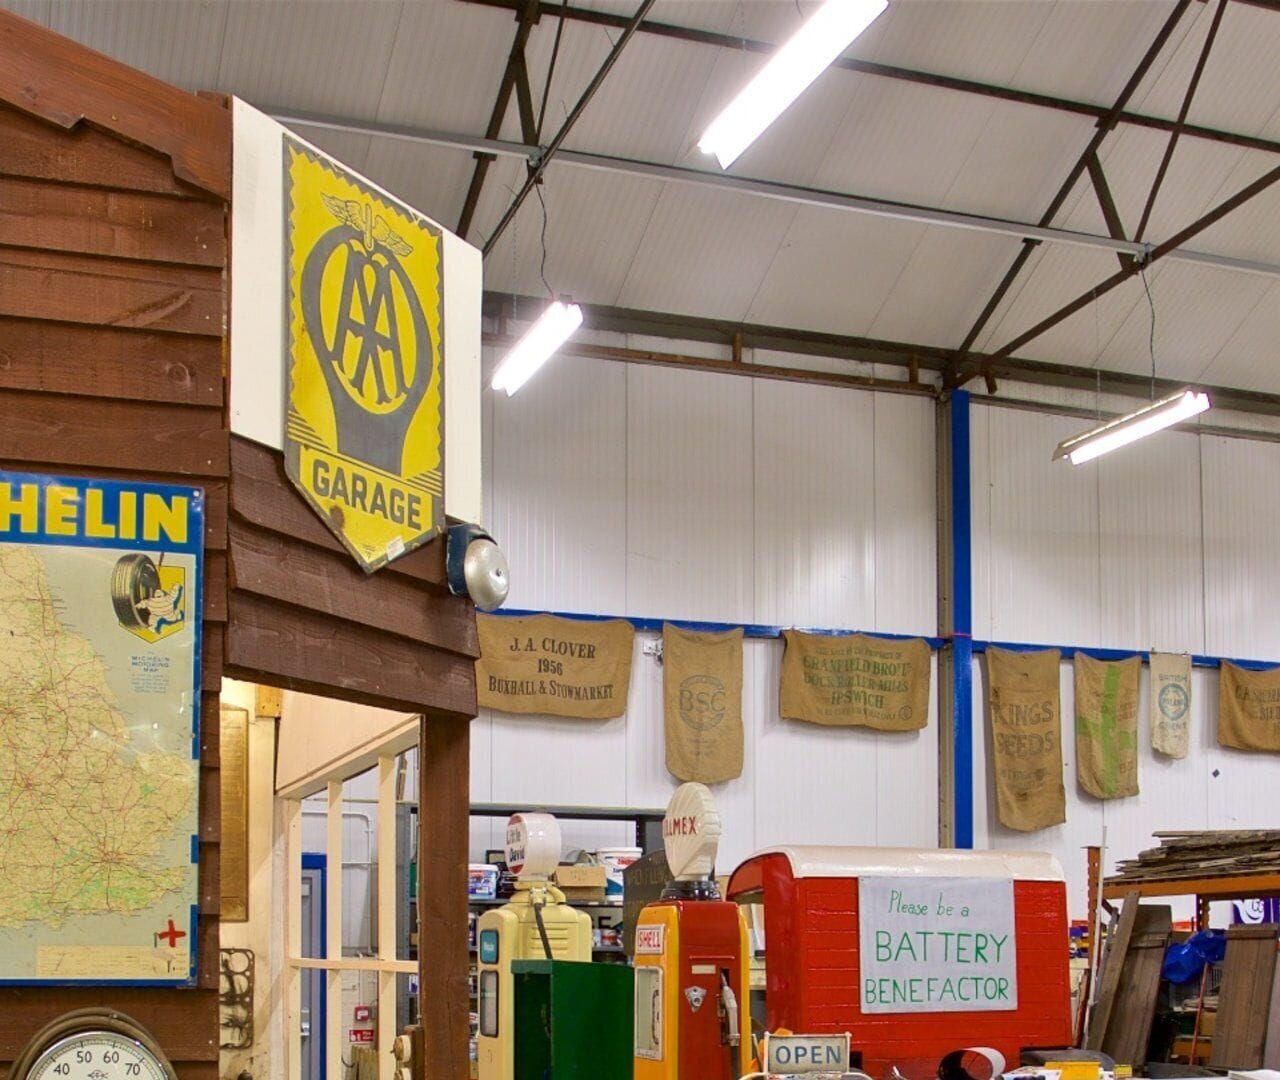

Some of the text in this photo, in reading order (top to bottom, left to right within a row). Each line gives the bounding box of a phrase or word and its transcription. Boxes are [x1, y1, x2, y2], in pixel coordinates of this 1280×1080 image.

[312, 458, 422, 531] GARAGE
[542, 637, 596, 659] CLOVER
[537, 659, 563, 676] 1956
[488, 675, 613, 701] BUXHALL & STOWMARKET
[679, 689, 726, 713] BSC
[831, 690, 885, 709] IPSWICH
[888, 890, 970, 918] Please be a
[638, 931, 661, 947] SHELL
[876, 930, 1009, 965] BATTERY
[865, 976, 1009, 1005] BENEFACTOR
[76, 1051, 93, 1063] 50
[103, 1051, 119, 1063] 60
[775, 1045, 842, 1064] OPEN
[53, 1063, 70, 1076] 40
[125, 1063, 141, 1076] 70
